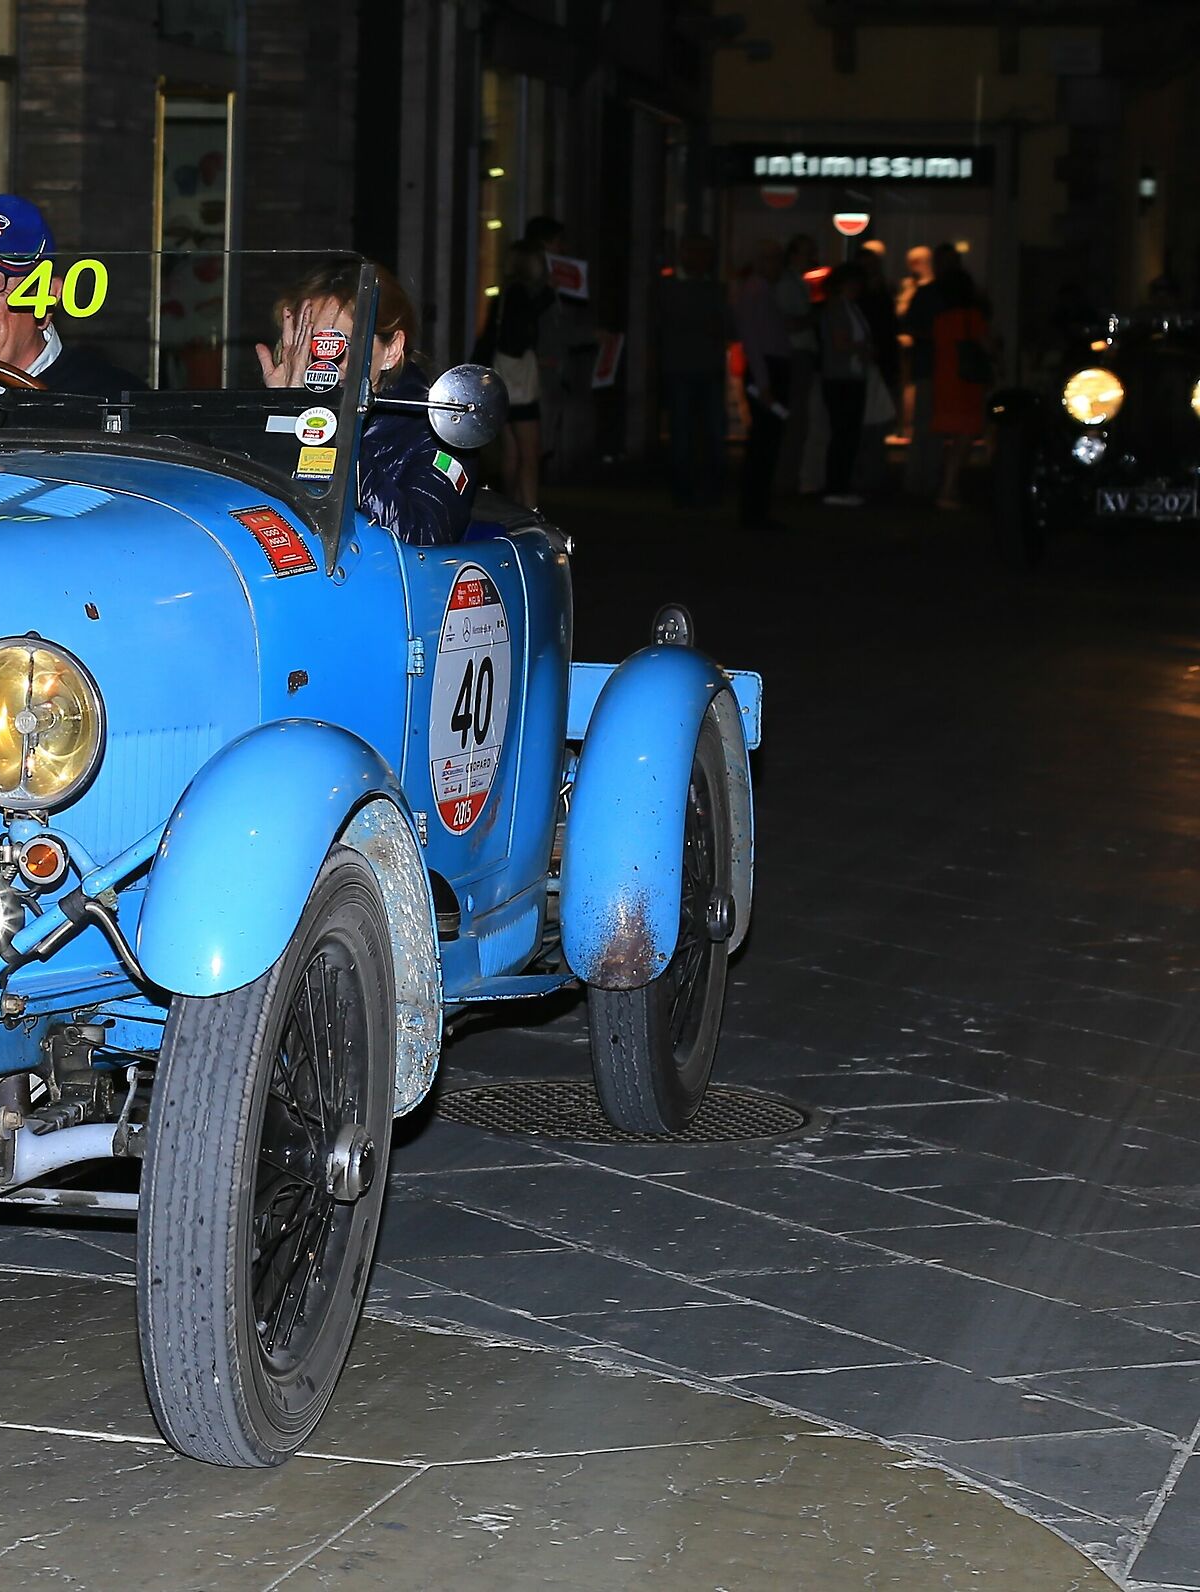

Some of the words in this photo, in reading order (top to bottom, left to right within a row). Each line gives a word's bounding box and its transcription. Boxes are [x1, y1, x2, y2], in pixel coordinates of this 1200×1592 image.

[754, 152, 973, 177] intimissimi
[6, 259, 109, 319] 40
[316, 340, 340, 351] 2015
[306, 372, 337, 382] VERIFICATO
[1135, 493, 1191, 512] 3207
[451, 656, 494, 749] 40
[453, 800, 473, 826] 2015
